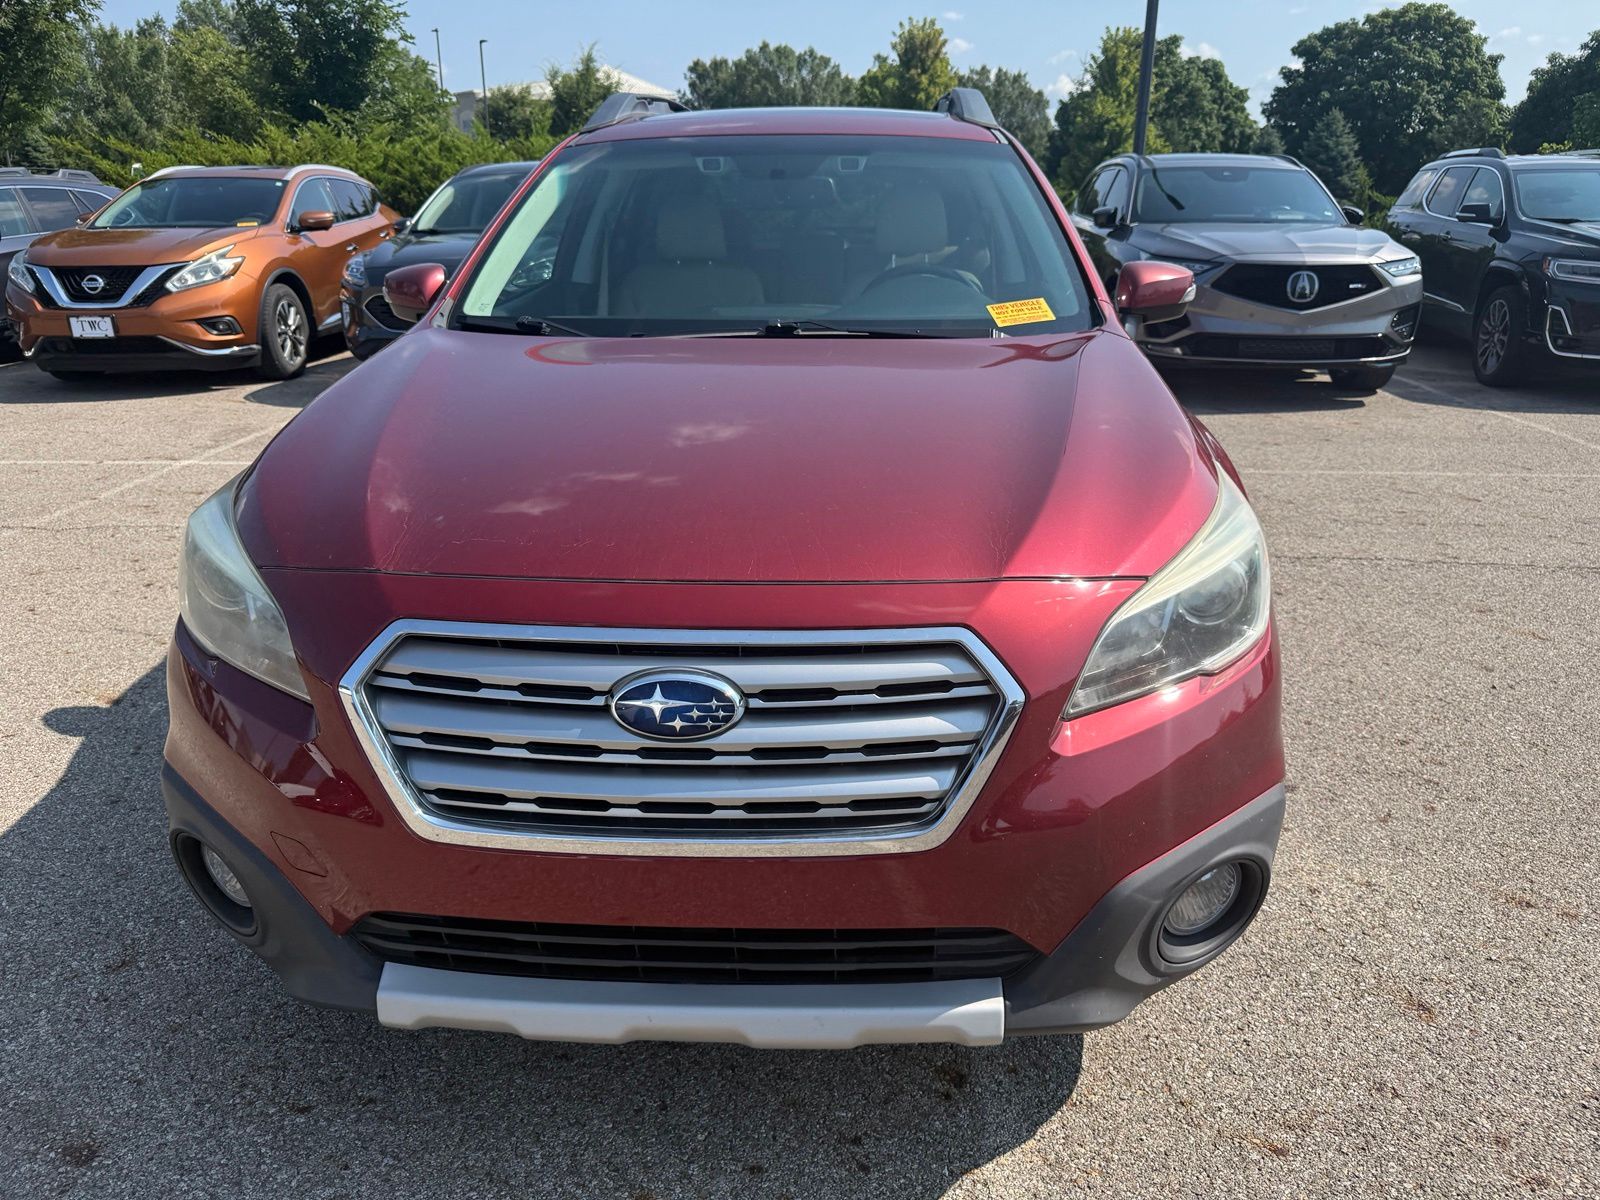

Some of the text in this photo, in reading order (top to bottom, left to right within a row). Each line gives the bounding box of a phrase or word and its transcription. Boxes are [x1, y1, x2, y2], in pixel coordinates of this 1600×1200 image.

[990, 300, 1042, 312] THIS VEHICLE
[77, 320, 109, 332] TWC
